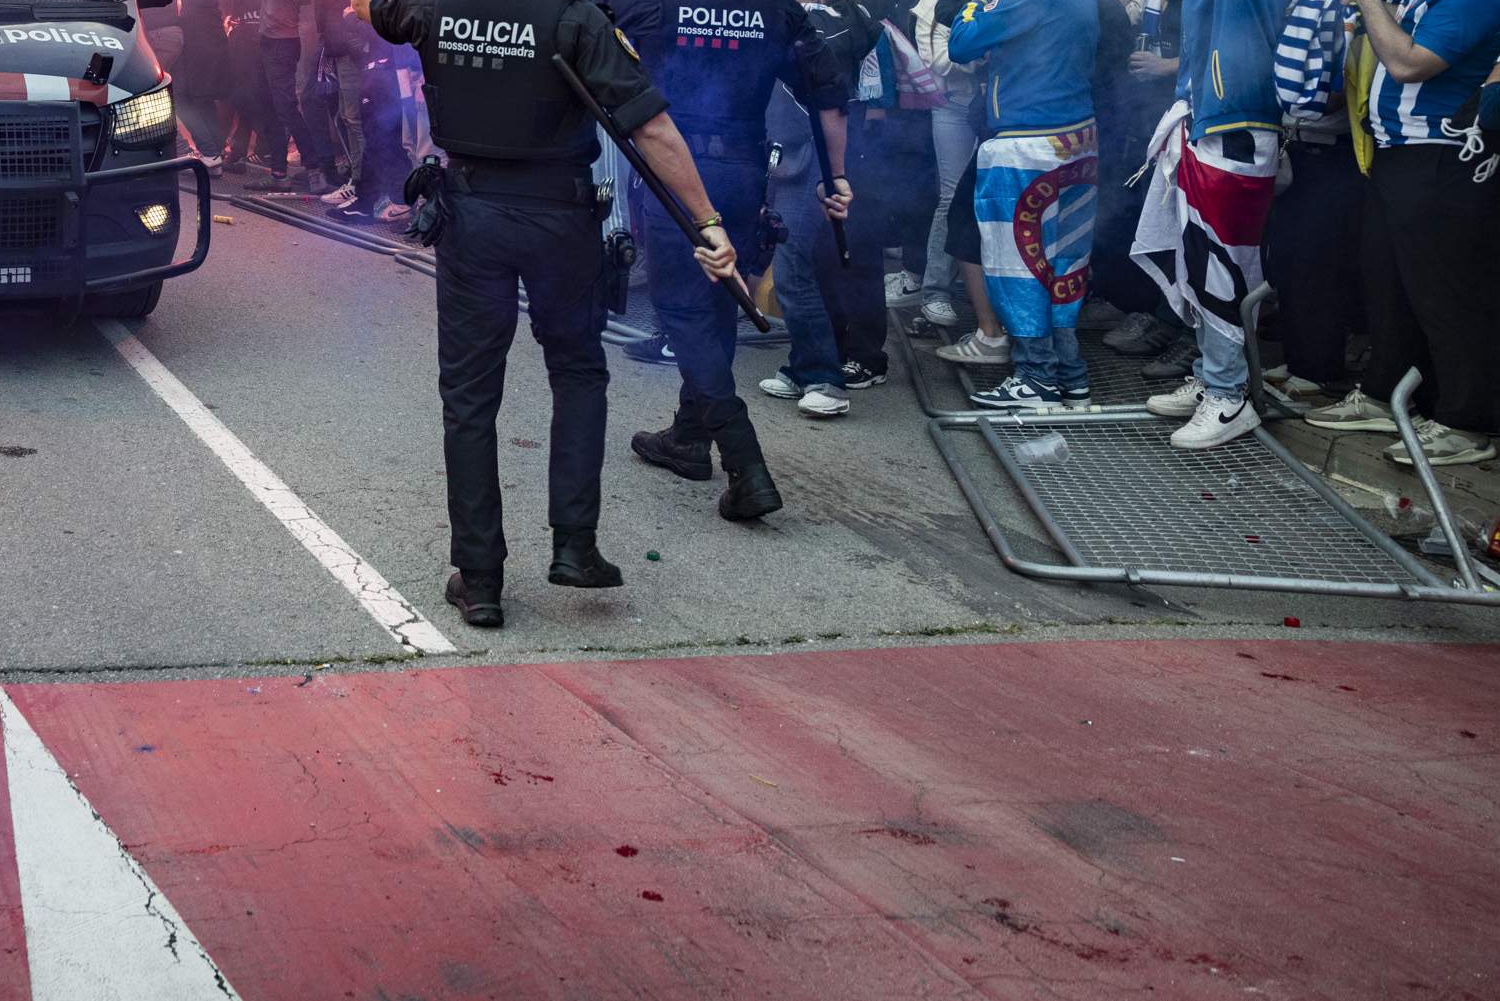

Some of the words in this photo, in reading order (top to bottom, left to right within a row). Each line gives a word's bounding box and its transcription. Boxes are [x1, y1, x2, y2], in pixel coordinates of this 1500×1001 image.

[677, 6, 765, 28] POLICIA
[3, 28, 125, 51] policia
[438, 16, 537, 46] POLICIA
[677, 26, 713, 37] mossos
[438, 41, 475, 53] mossos
[1019, 181, 1054, 225] RCD
